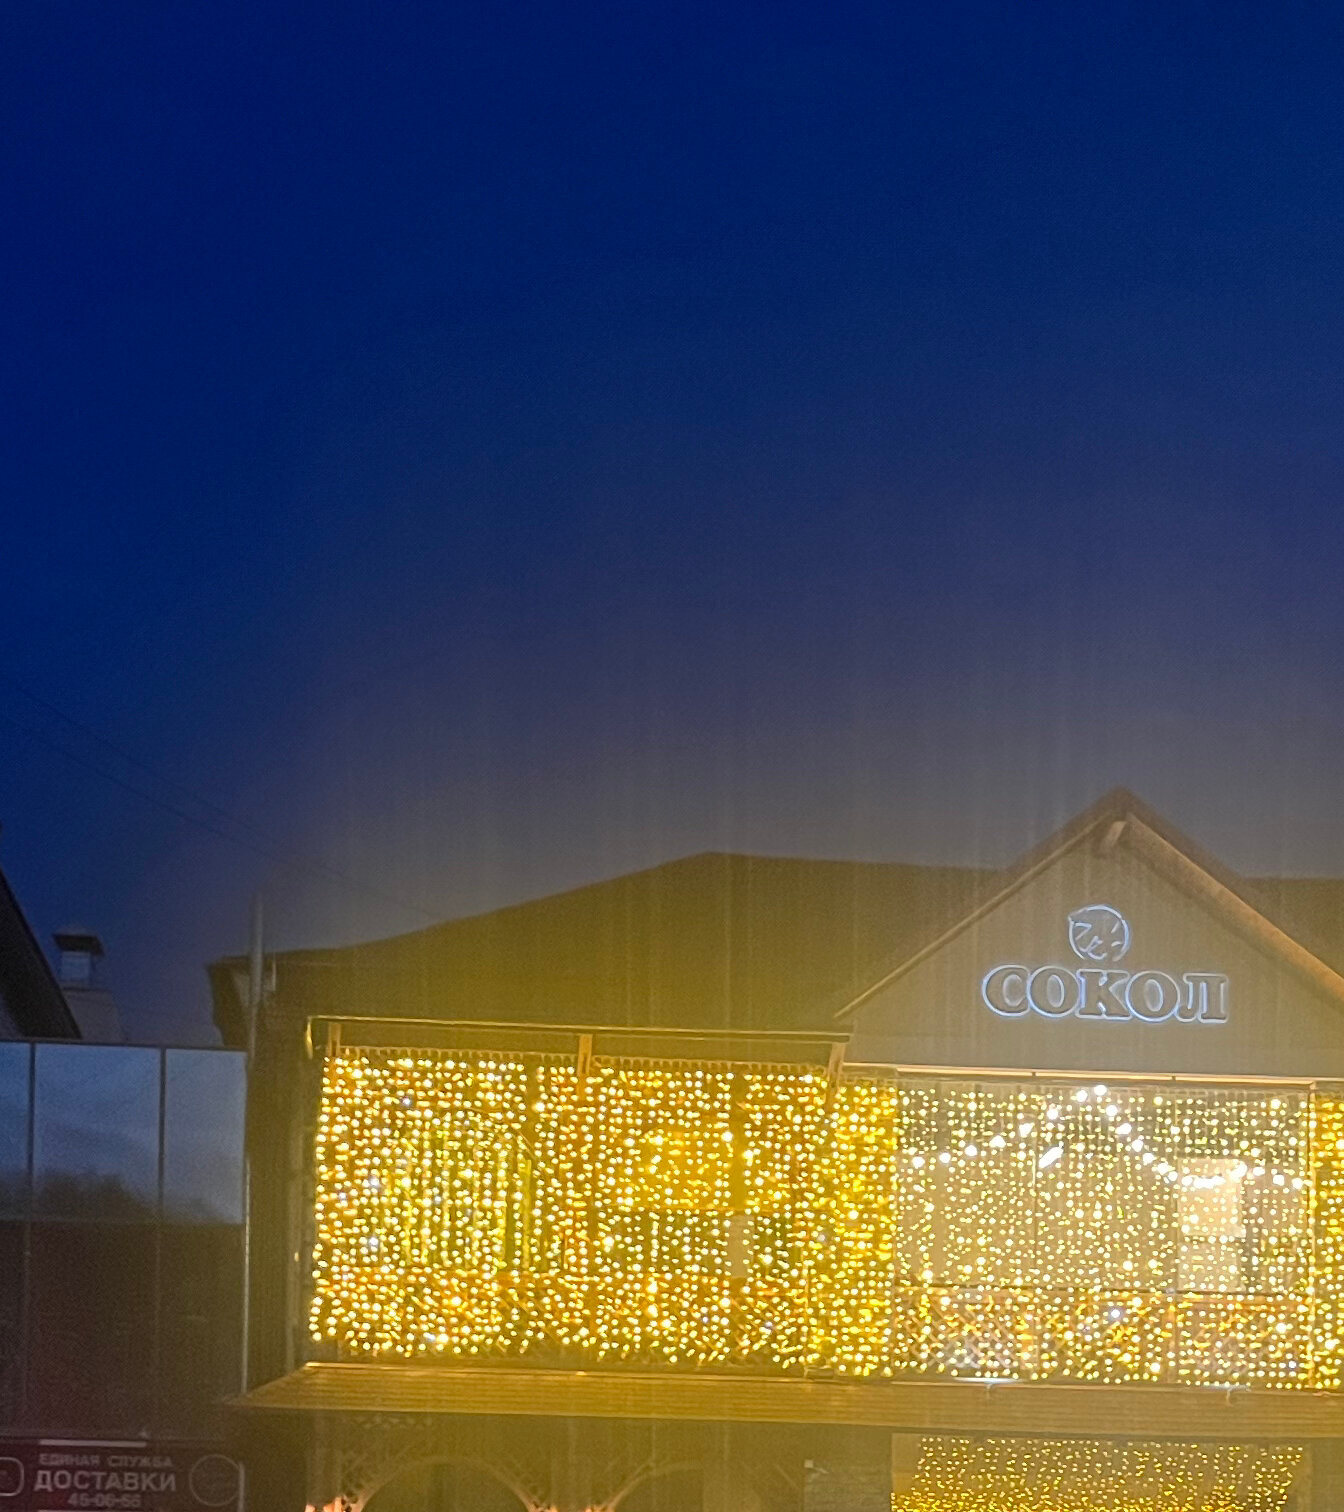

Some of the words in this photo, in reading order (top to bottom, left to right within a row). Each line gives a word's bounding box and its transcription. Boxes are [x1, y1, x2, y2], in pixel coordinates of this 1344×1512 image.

[982, 964, 1229, 1024] СОКОЛ
[39, 1453, 100, 1467] ЕДИНАЯ
[107, 1455, 173, 1468] СЛУЖБА
[34, 1470, 176, 1492] ДОСТАВКИ
